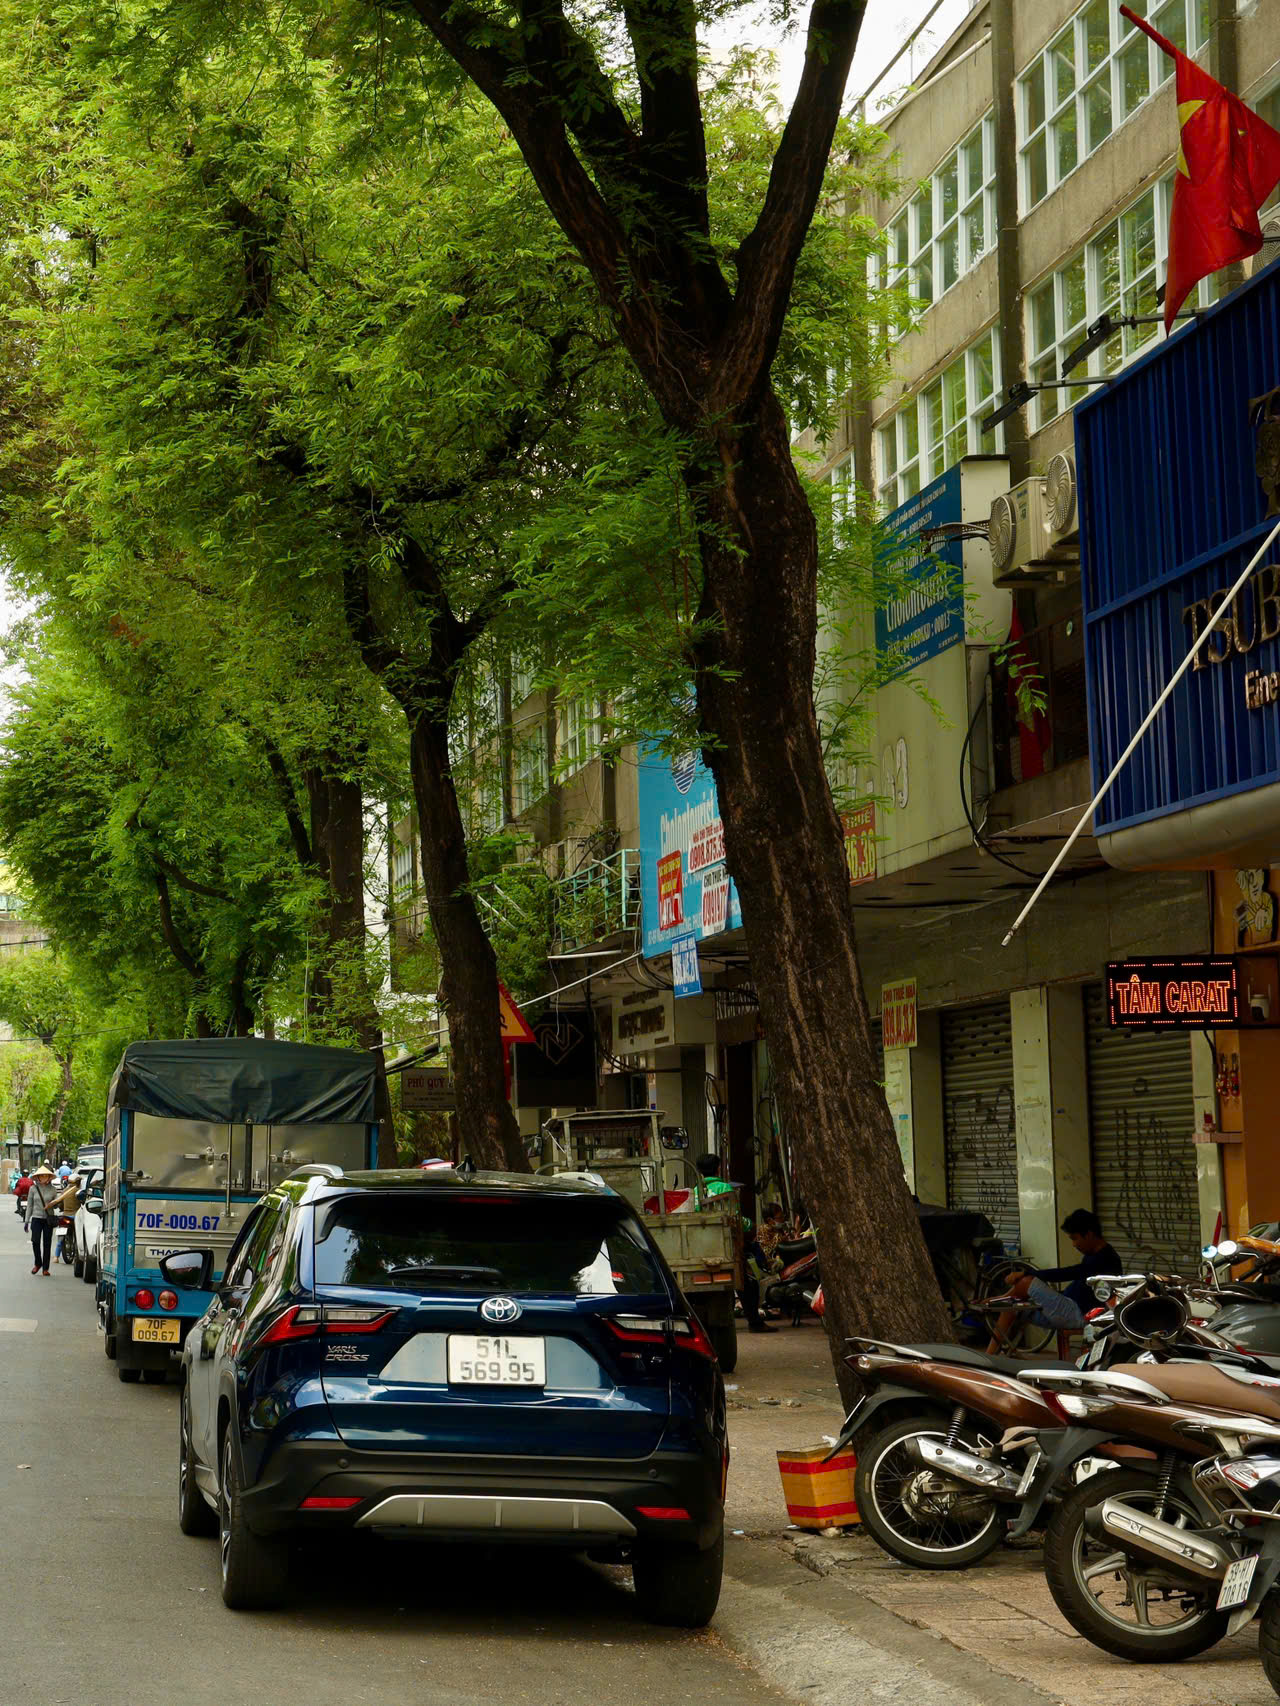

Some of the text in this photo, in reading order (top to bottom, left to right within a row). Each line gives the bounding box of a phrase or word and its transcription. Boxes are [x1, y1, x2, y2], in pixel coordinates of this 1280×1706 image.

[1116, 974, 1231, 1014] TÂM CARAT
[137, 1212, 220, 1231] 70F-009.67
[146, 1319, 167, 1330] 70F
[137, 1329, 175, 1342] 009.67
[325, 1354, 370, 1362] CROSS
[475, 1338, 518, 1360] 51L
[459, 1361, 536, 1382] 569.95
